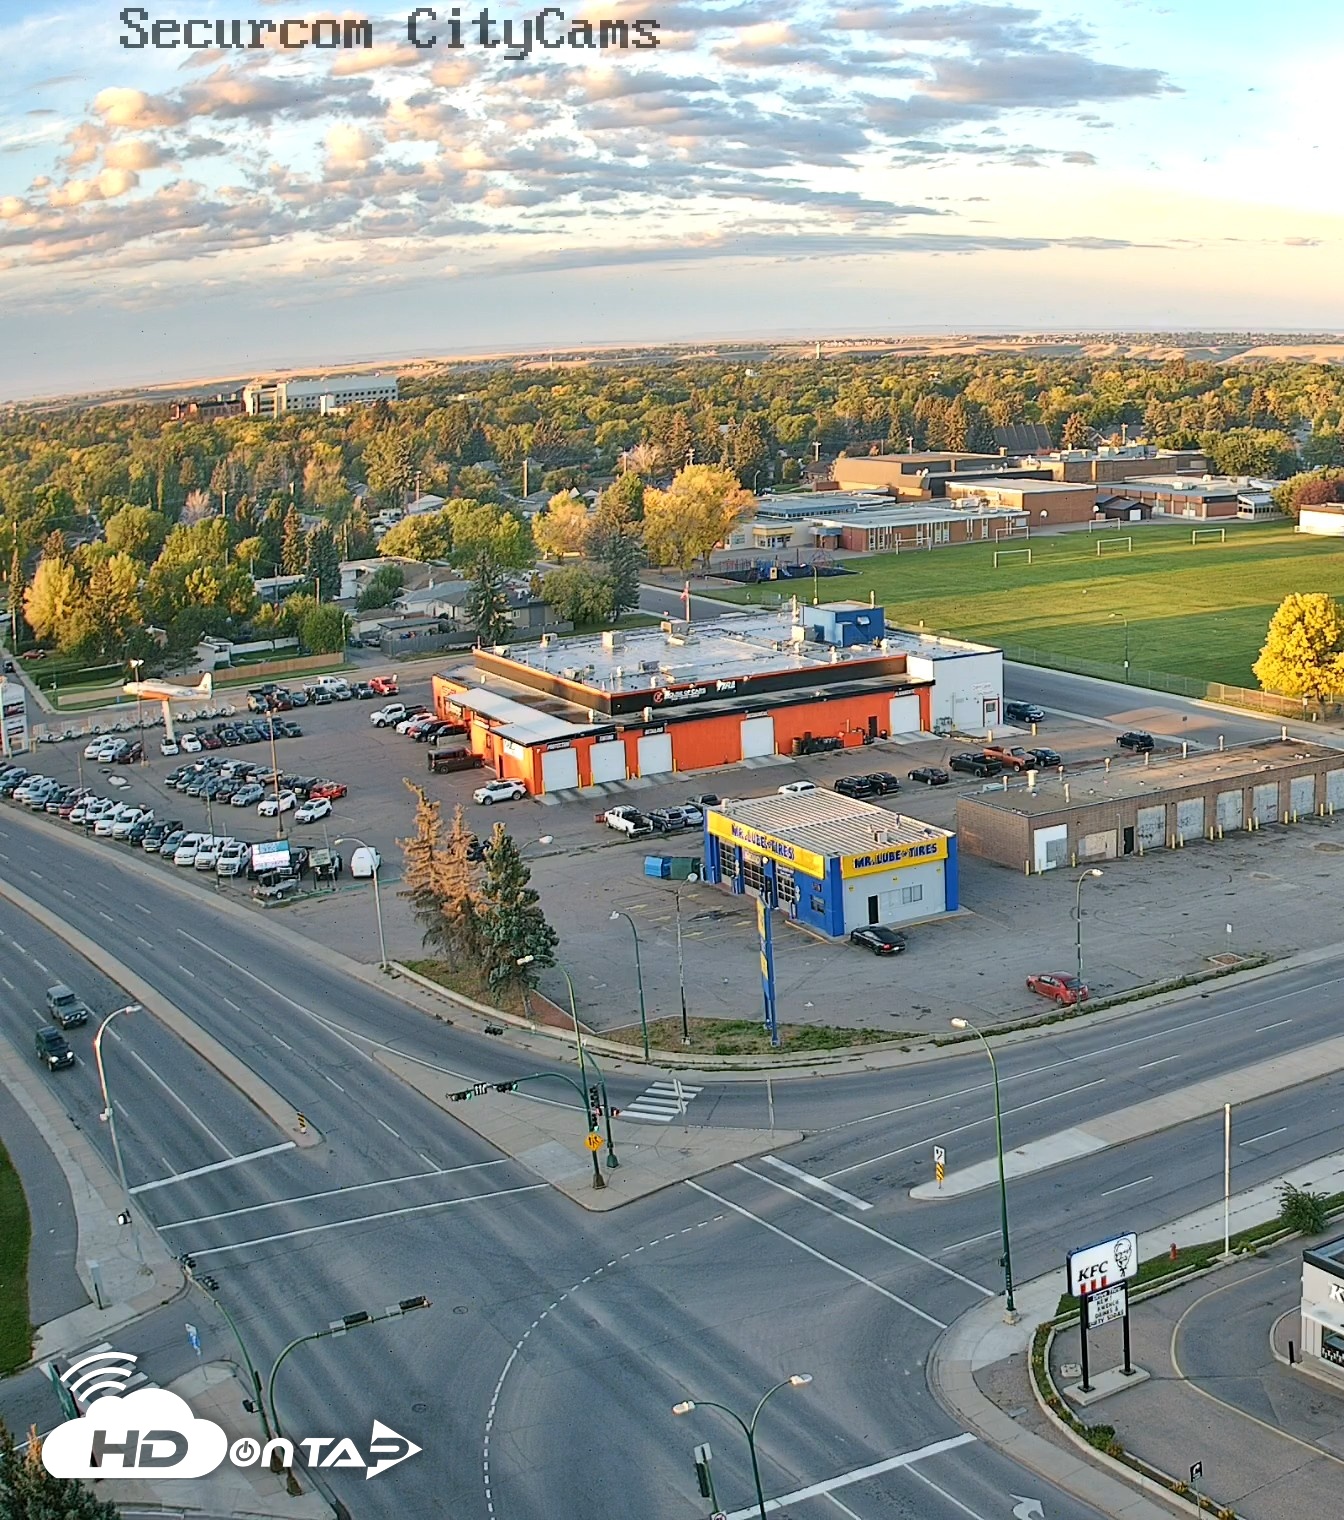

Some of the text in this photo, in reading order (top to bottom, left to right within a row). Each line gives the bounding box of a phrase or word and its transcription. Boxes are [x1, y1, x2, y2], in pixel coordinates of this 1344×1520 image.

[746, 831, 767, 848] LUBE
[772, 840, 794, 860] TIRES
[876, 850, 901, 864] LUBE
[908, 843, 937, 857] TIRES
[1078, 1261, 1108, 1282] KFC
